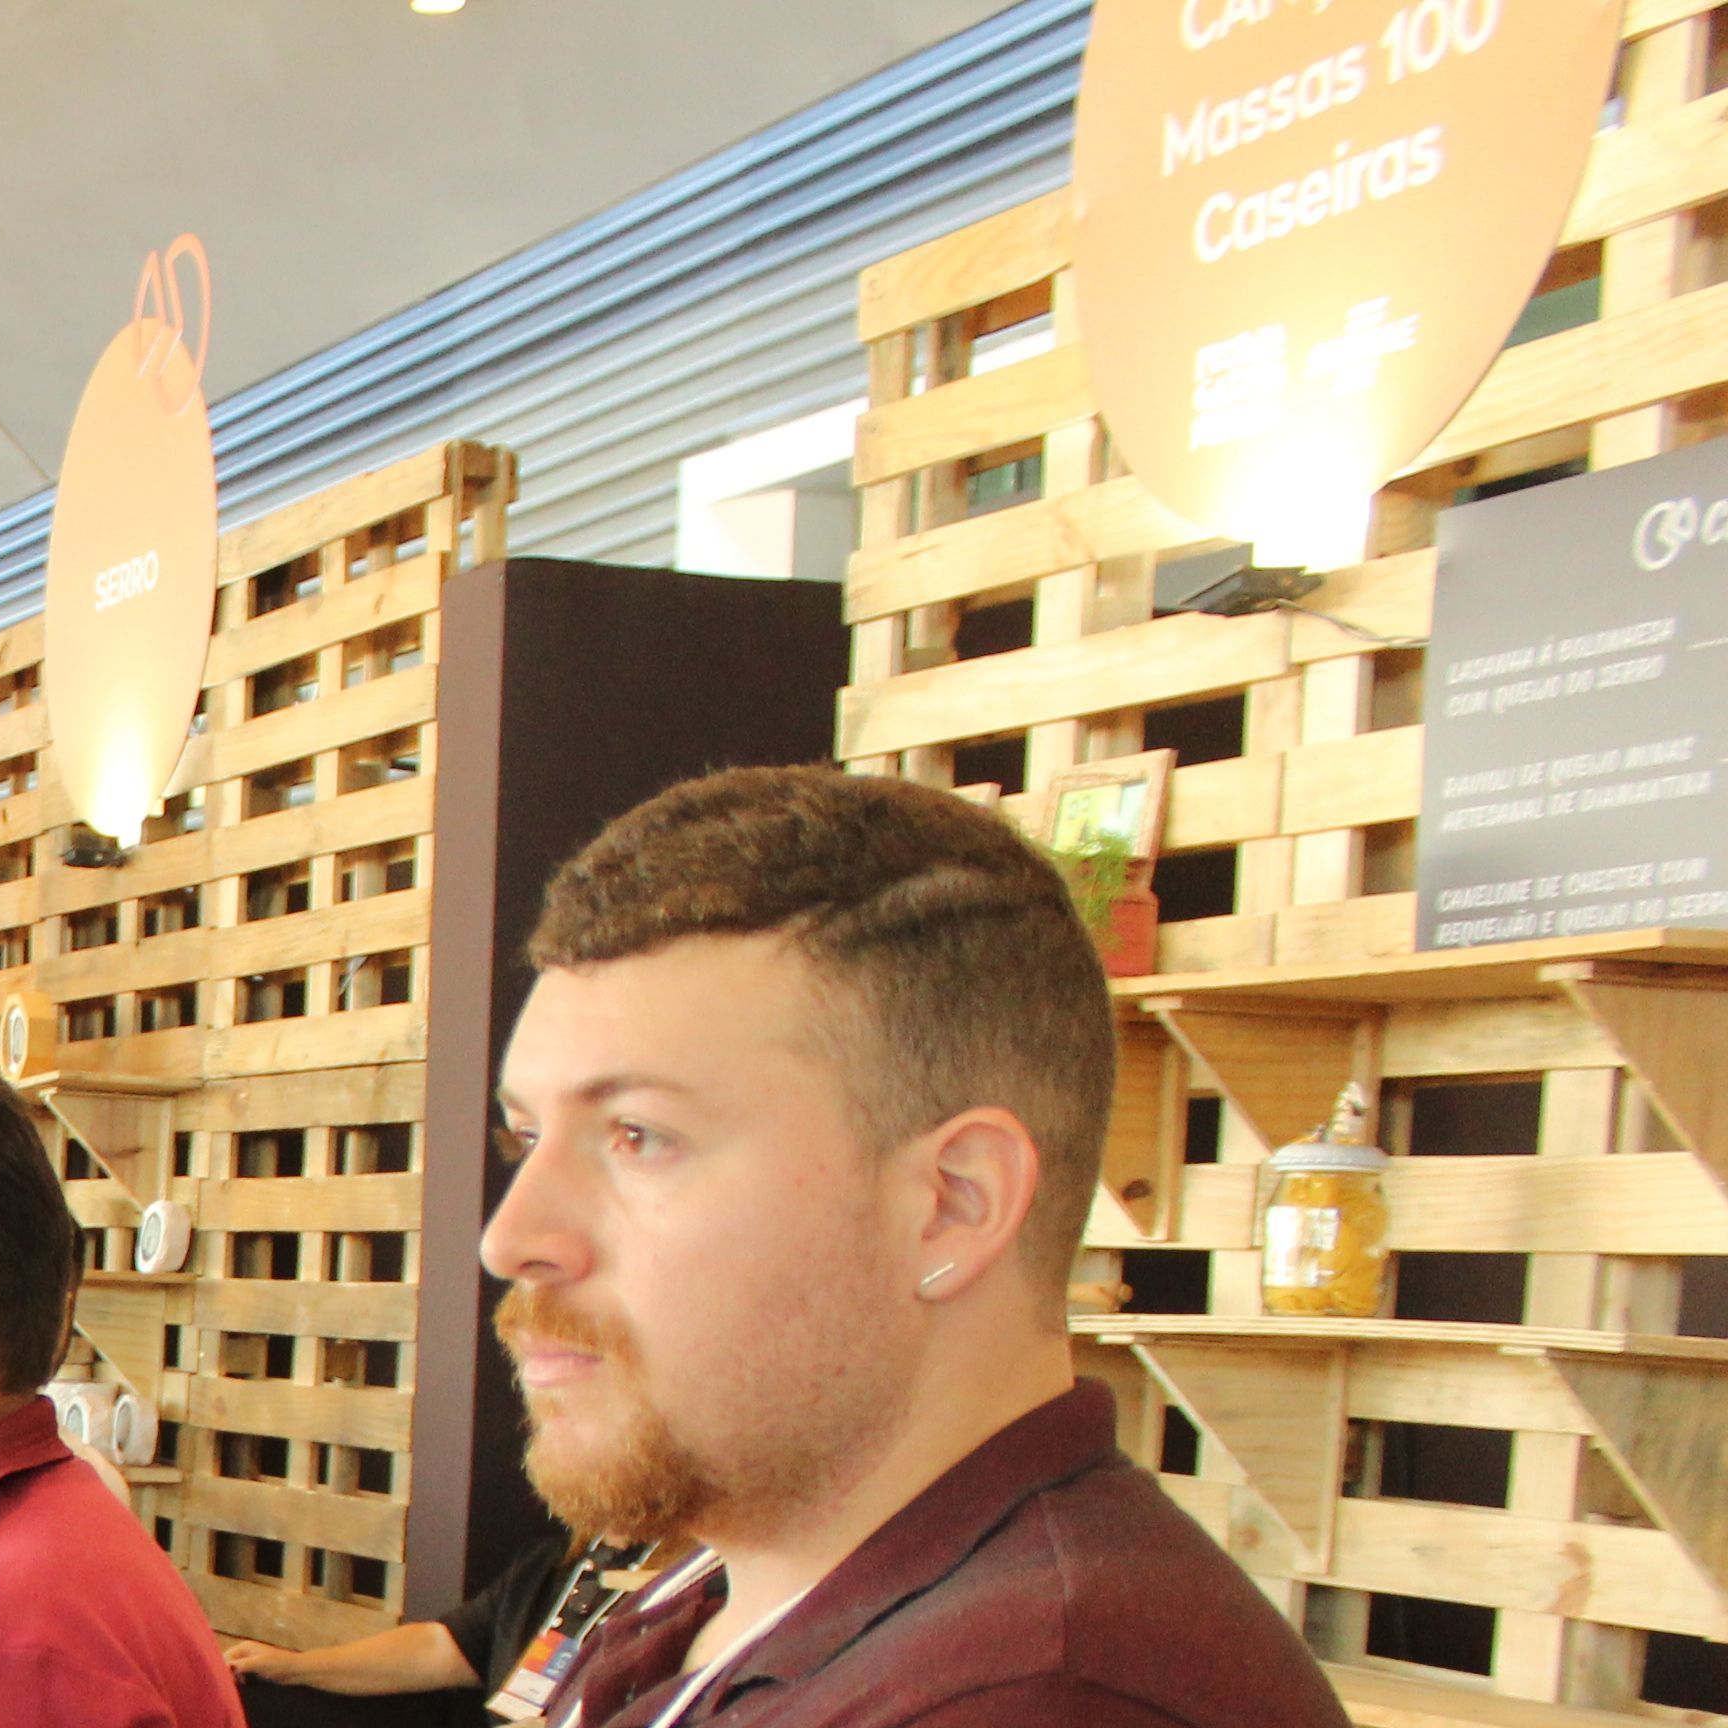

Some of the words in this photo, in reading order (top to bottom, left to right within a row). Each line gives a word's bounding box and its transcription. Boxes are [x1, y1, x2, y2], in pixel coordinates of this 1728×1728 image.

[1161, 43, 1367, 177] Massas
[1378, 0, 1500, 84] 100
[1193, 124, 1446, 264] Caseiras
[94, 549, 160, 613] SERRO
[1447, 646, 1535, 685] LASANHA
[1447, 689, 1489, 717] COM
[1493, 673, 1564, 714] QUEIJO
[1566, 668, 1595, 695] DO
[1597, 654, 1665, 688] SERRO
[1517, 761, 1545, 786] DE
[1547, 749, 1621, 787] QUEIJO
[1440, 798, 1545, 832] ARTESANAL
[1550, 790, 1578, 816] DE
[1437, 877, 1533, 913] CANELONE
[1535, 875, 1562, 899] DE
[1567, 863, 1655, 896] CHESTER
[1658, 857, 1708, 885] COM
[1436, 909, 1538, 947] REQUEIJÃO
[1540, 910, 1556, 934] E
[1560, 902, 1630, 937] QUEIJO
[1633, 898, 1664, 923] DO
